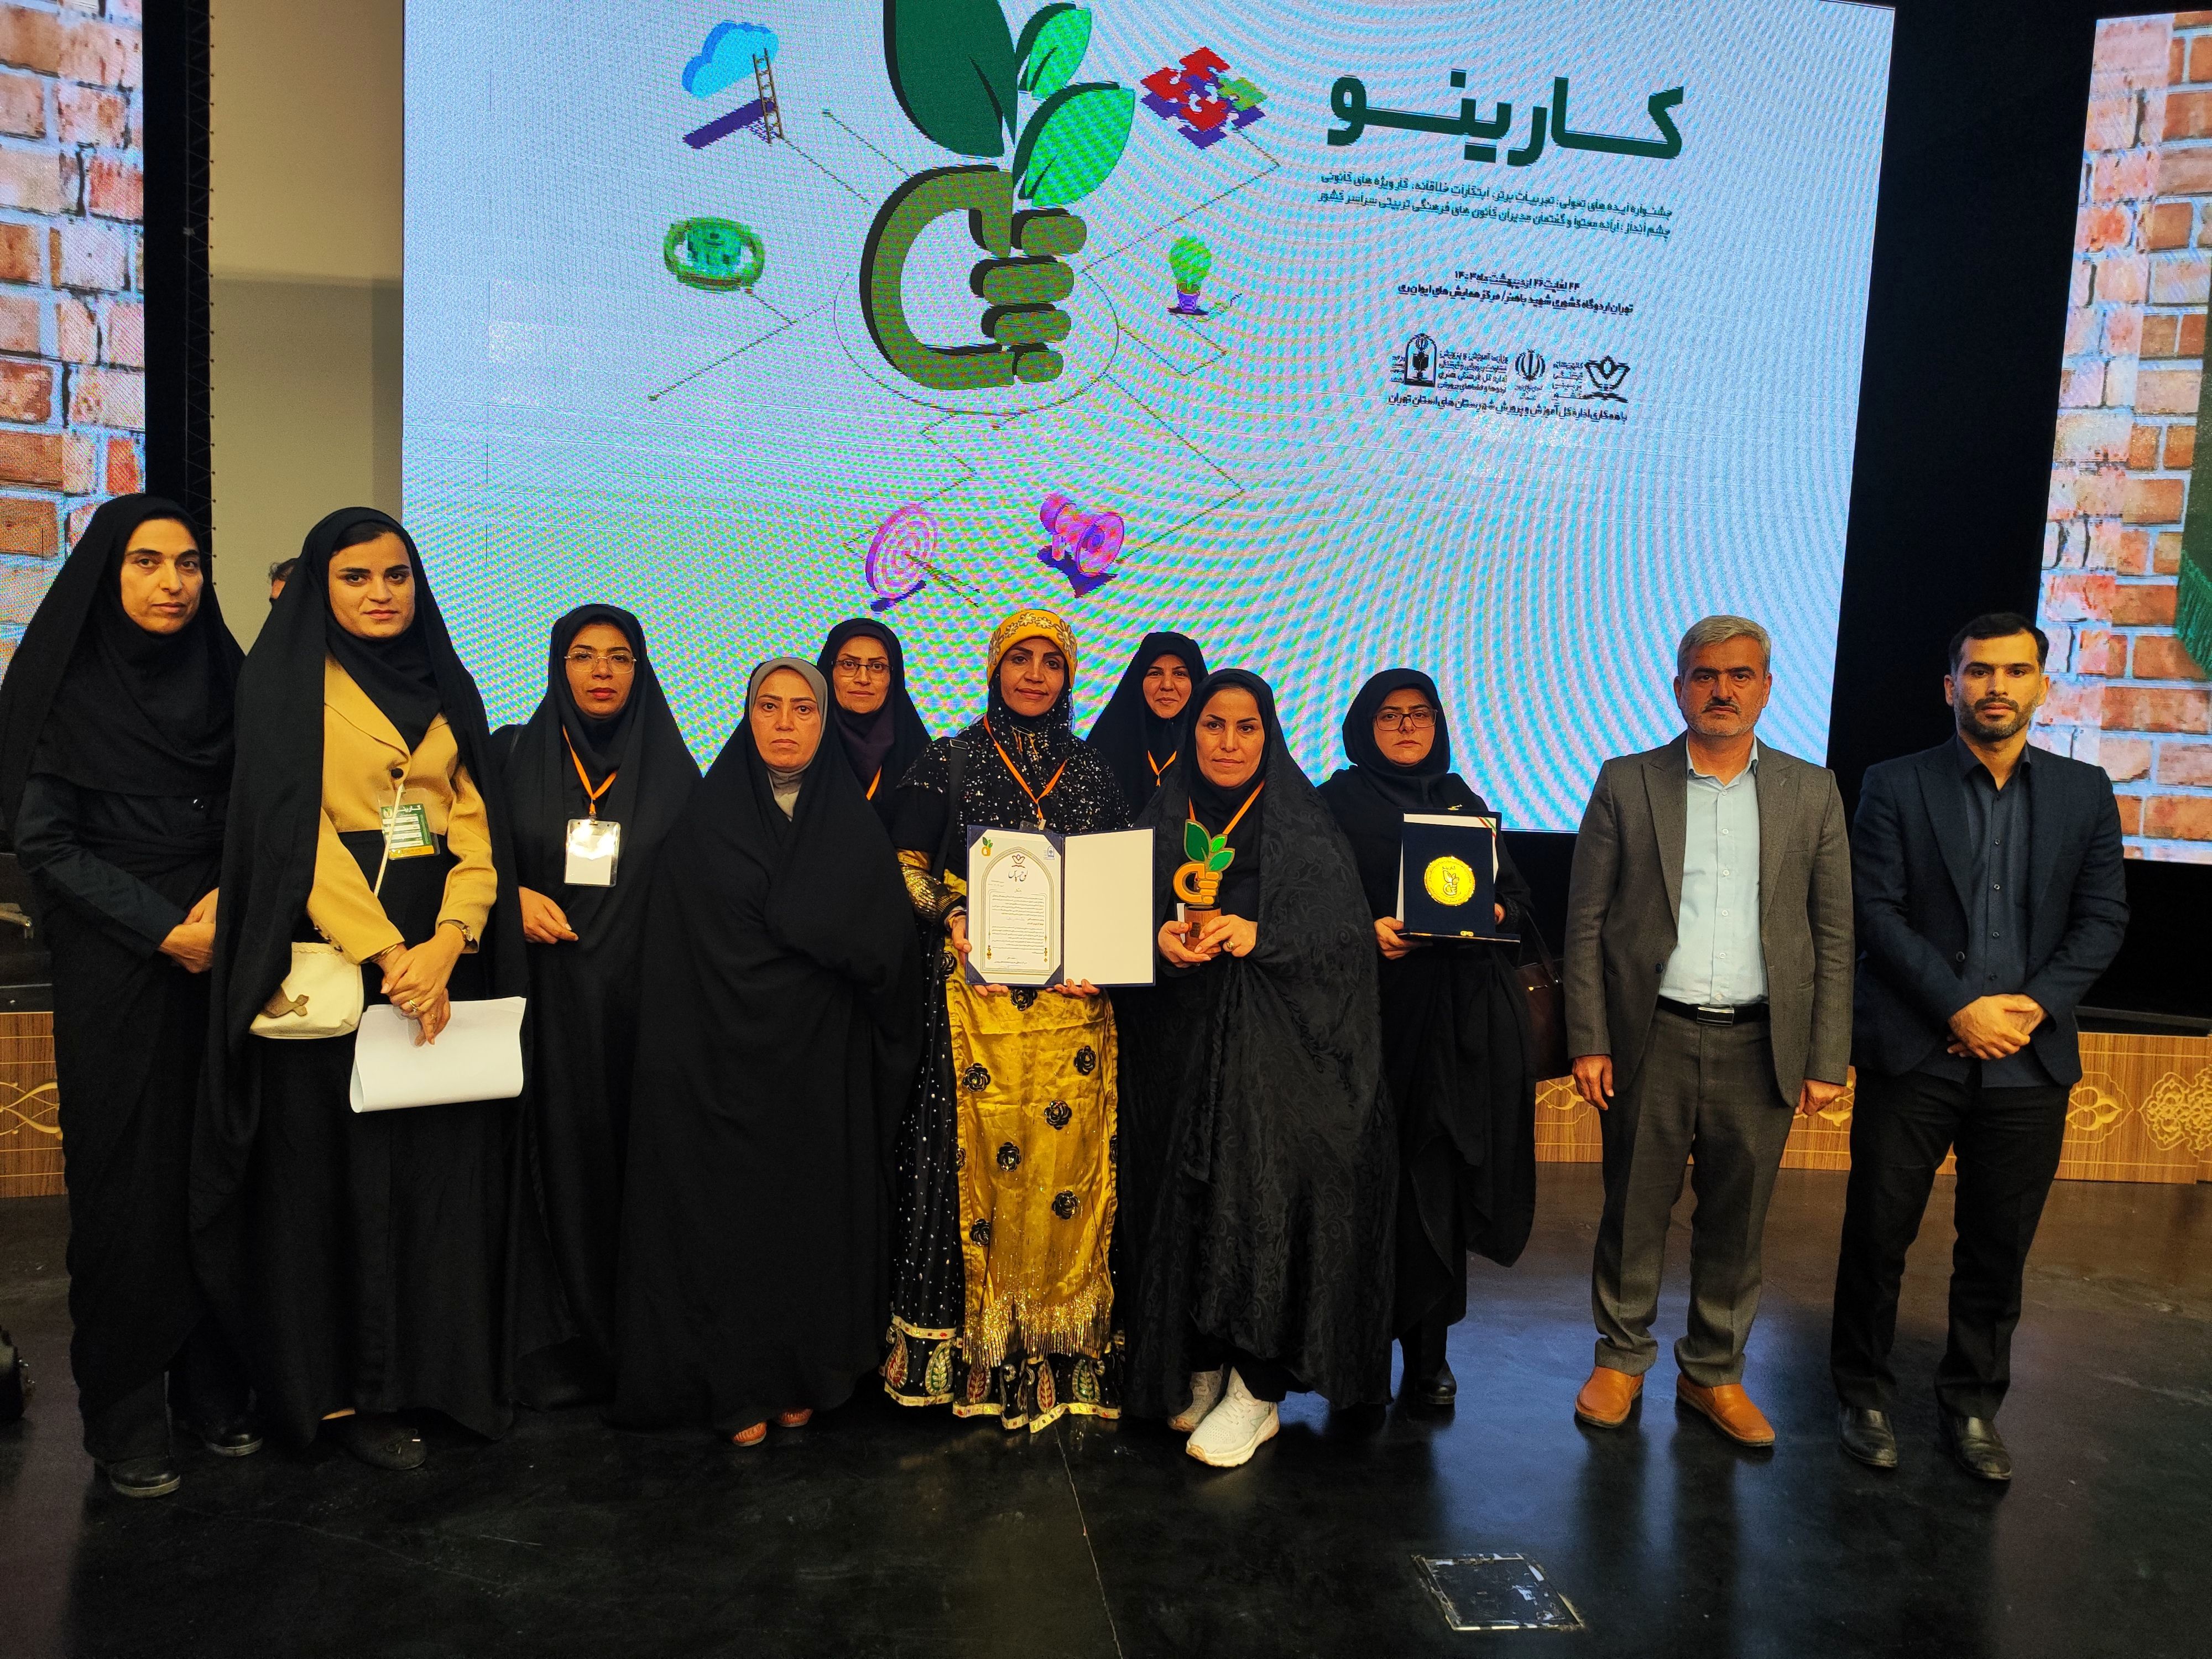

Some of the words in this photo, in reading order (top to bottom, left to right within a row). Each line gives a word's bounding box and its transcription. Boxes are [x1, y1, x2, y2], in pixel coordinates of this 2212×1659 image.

[1327, 69, 1684, 167] کارینو
[1321, 171, 1352, 184] کانونی
[1355, 174, 1372, 186] های
[1374, 175, 1394, 190] ویژه
[1395, 178, 1408, 191] کار
[1318, 189, 1344, 202] کشور
[1451, 184, 1490, 200] ابتکارات
[1516, 191, 1555, 206] تجربیات
[1345, 193, 1377, 206] سراسر
[1379, 198, 1410, 211] تربیتی
[1588, 199, 1605, 211] های
[1412, 198, 1449, 215] فرهنگی
[1452, 204, 1469, 216] های
[1472, 207, 1496, 219] کانون
[1607, 202, 1629, 215] ایده
[1631, 206, 1672, 220] جشنواره
[1498, 208, 1532, 223] مدیران
[1533, 213, 1566, 226] گفتمان
[1566, 218, 1572, 228] و
[1574, 216, 1597, 229] محتوا
[1599, 220, 1619, 233] ارائه
[1646, 222, 1671, 241] چشم
[1491, 272, 1532, 289] اردیبهشت
[1432, 285, 1449, 298] های
[1449, 285, 1480, 300] همایش
[1480, 289, 1501, 302] مرکز
[1505, 293, 1527, 305] باهنر
[1528, 294, 1552, 307] شهید
[1552, 295, 1581, 310] کشوری
[1581, 298, 1610, 313] اردوگاه
[1610, 302, 1634, 315] تهران
[1389, 393, 1412, 406] تهران
[1530, 403, 1559, 418] آموزش
